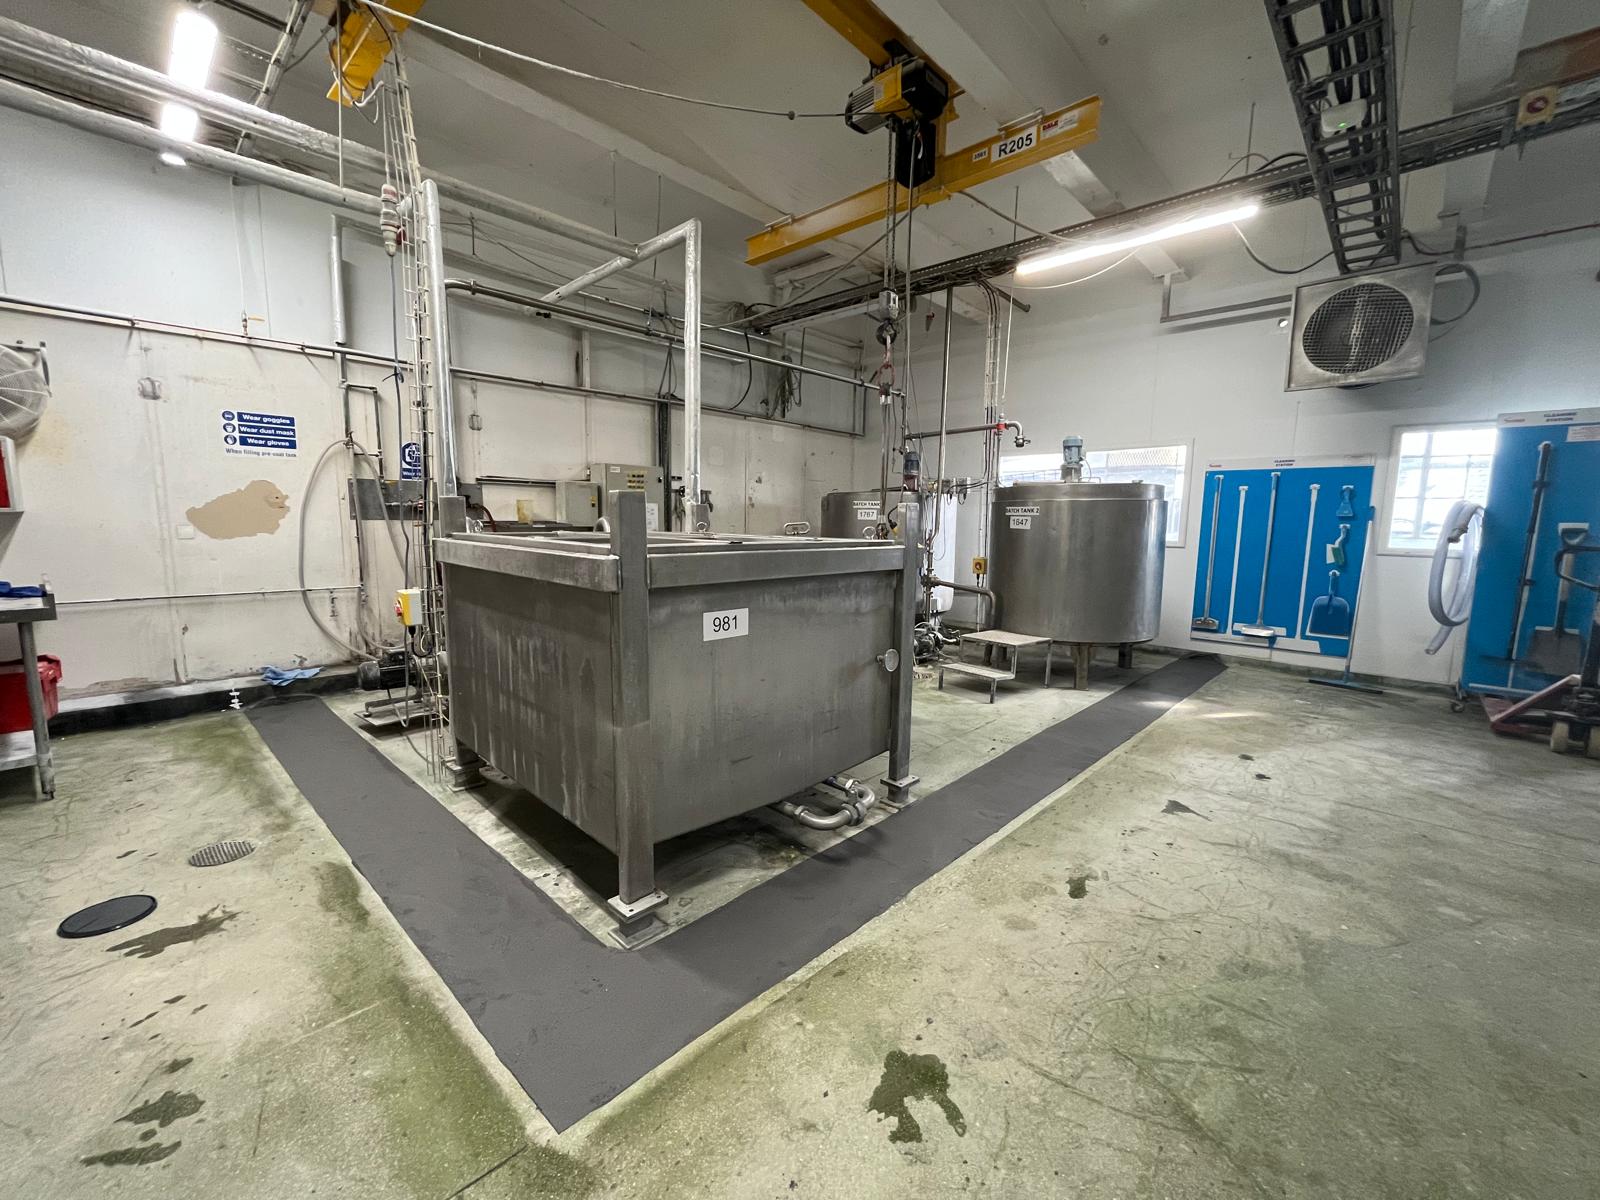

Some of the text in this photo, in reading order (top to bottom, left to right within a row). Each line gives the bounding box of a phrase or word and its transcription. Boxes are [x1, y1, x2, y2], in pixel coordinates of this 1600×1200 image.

[998, 132, 1033, 158] R205
[1012, 518, 1029, 526] 1647
[713, 615, 738, 633] 981
